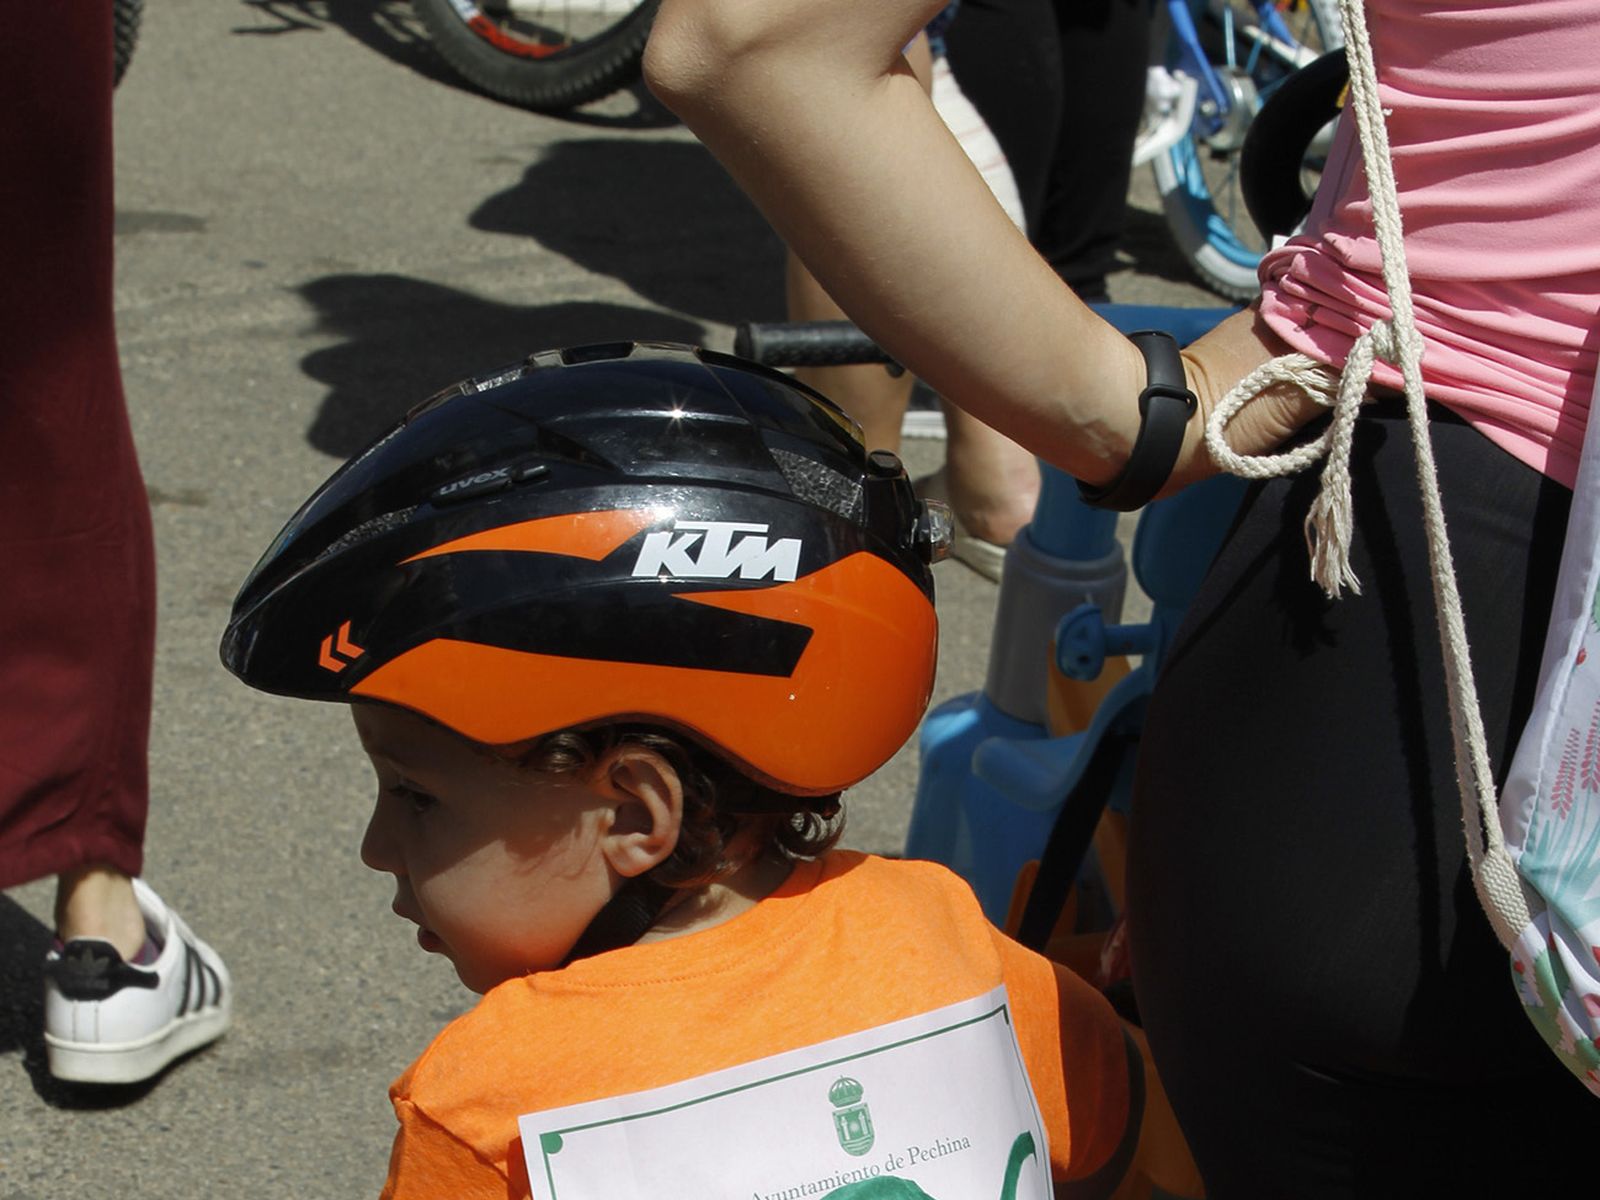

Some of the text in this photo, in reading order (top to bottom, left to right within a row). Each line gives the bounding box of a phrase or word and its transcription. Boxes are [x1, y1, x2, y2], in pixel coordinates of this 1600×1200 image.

[439, 465, 512, 496] uvex
[631, 519, 802, 583] KTM
[884, 1155, 905, 1173] de
[906, 1135, 971, 1166] Pechina
